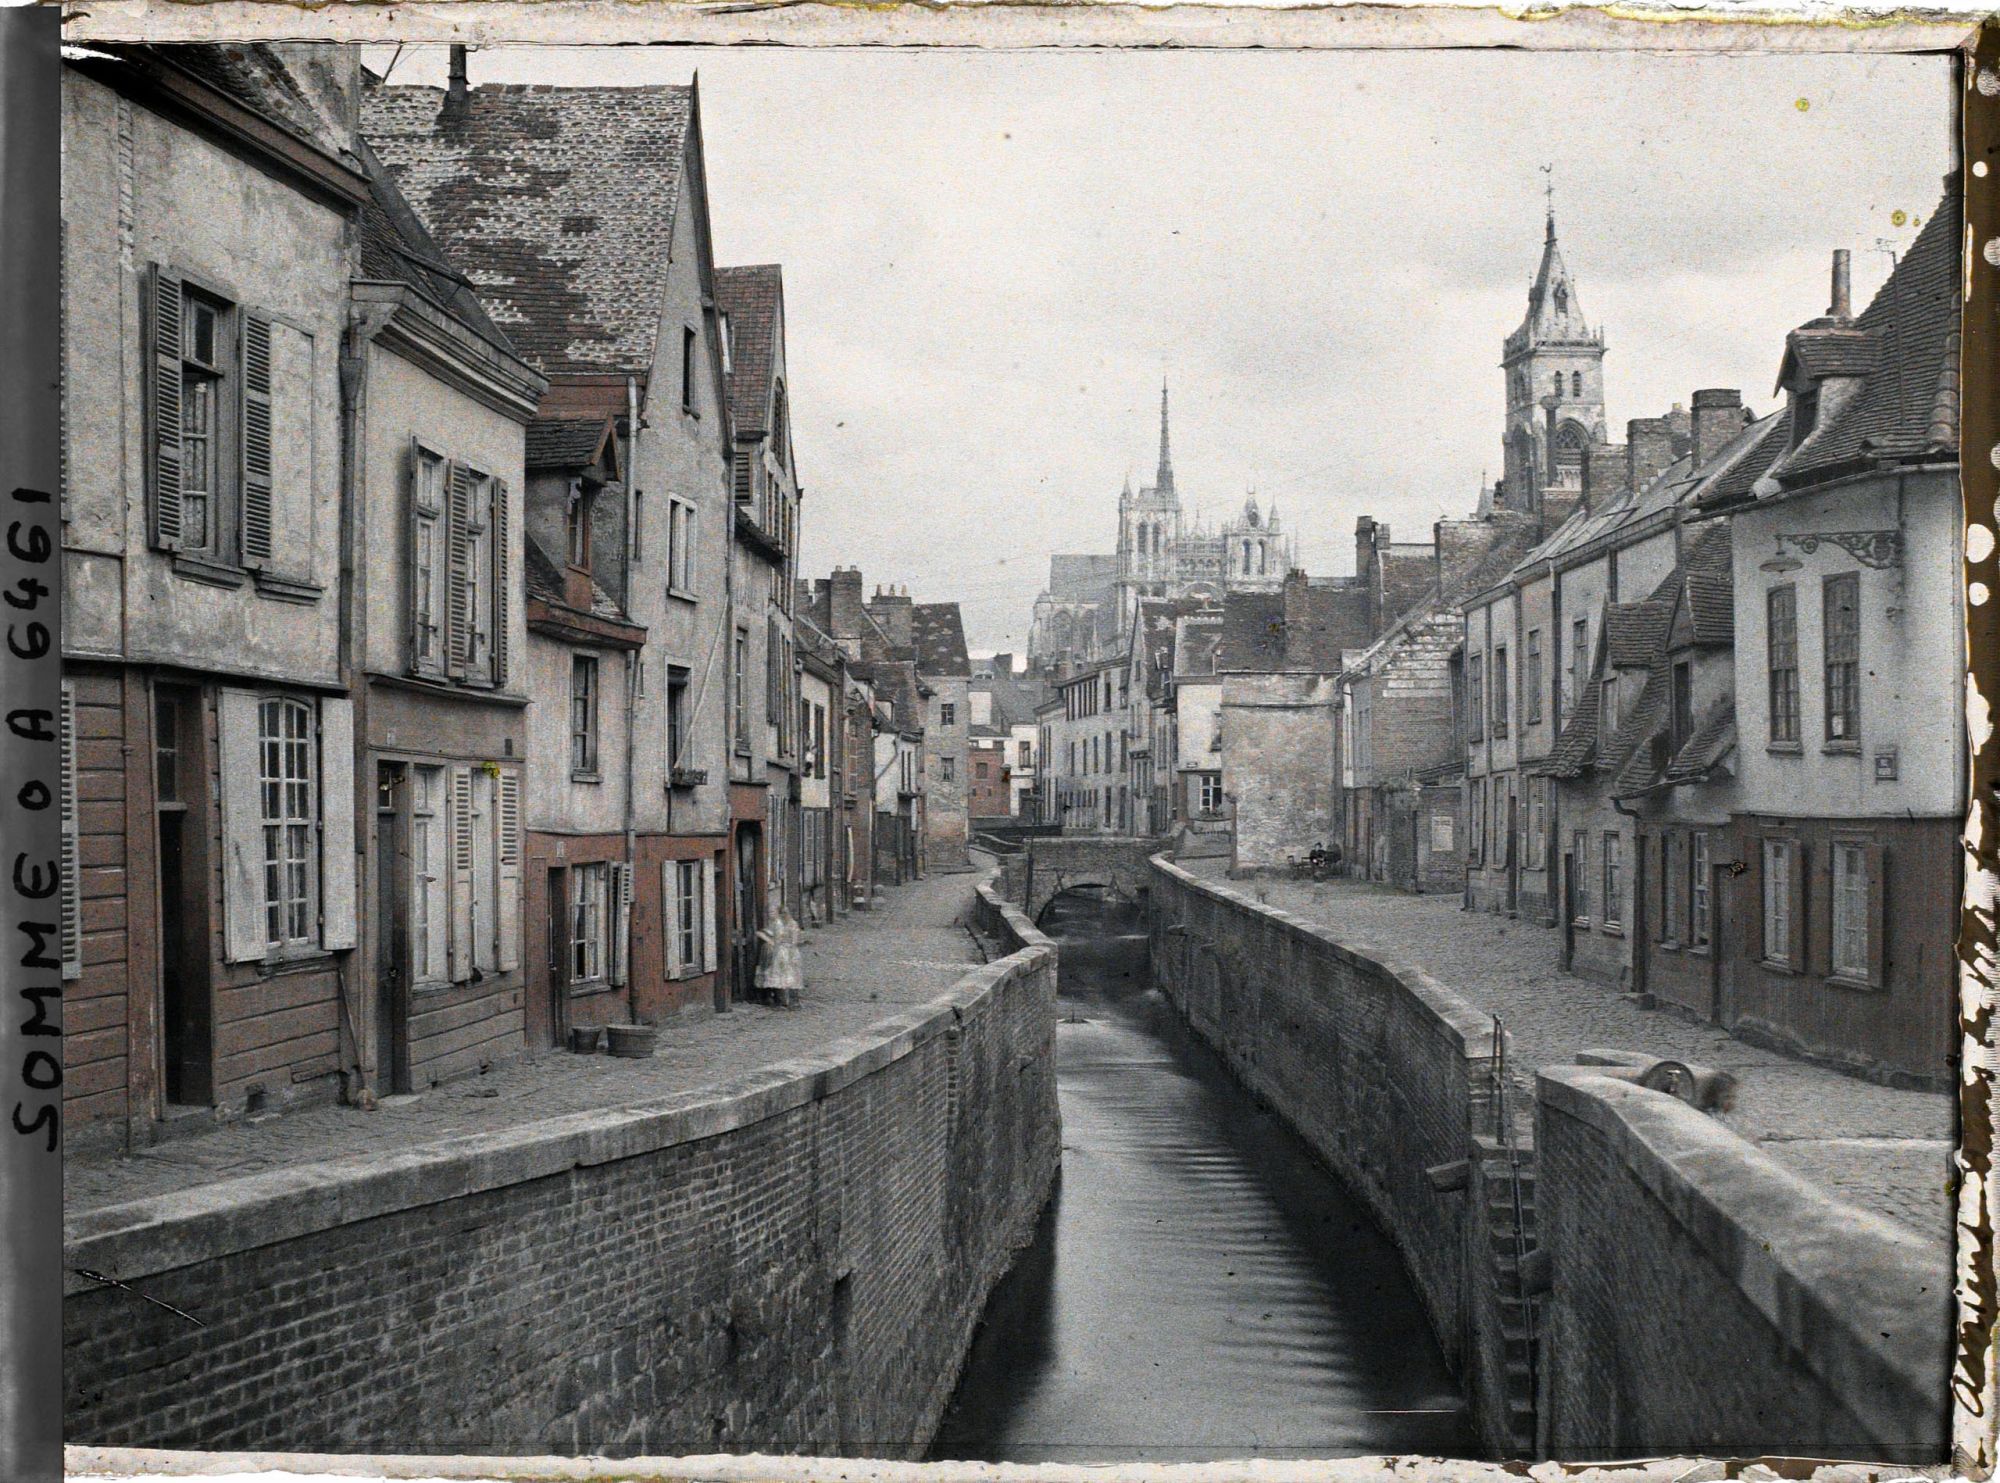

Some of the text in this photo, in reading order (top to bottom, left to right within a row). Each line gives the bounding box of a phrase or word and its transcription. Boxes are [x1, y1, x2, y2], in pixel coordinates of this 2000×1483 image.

[2, 487, 52, 660] 6461
[6, 708, 57, 743] A
[12, 852, 63, 1154] SOMME
